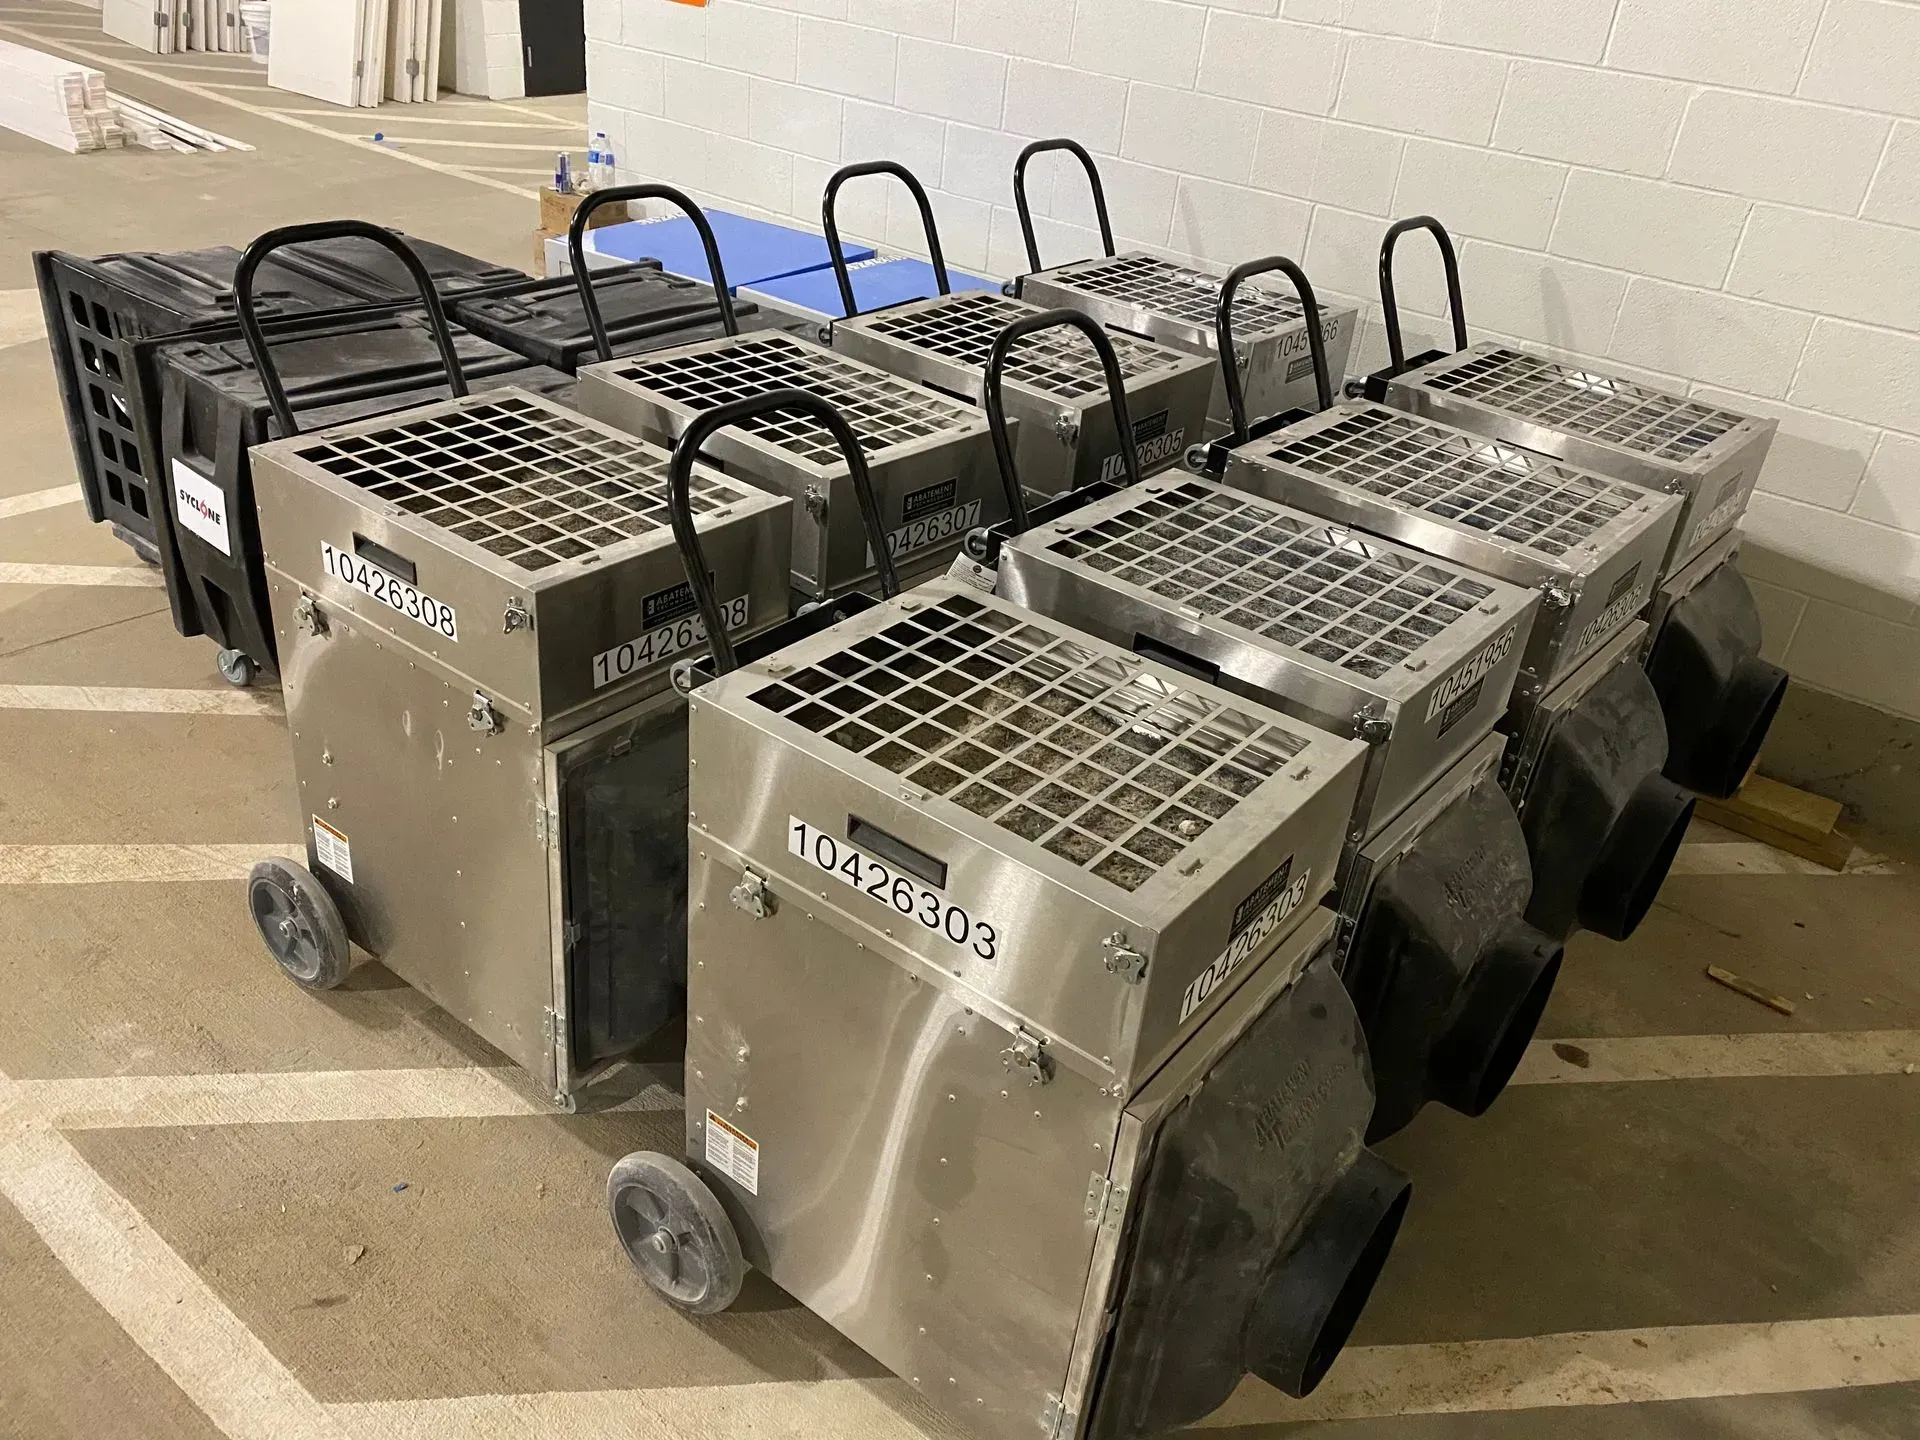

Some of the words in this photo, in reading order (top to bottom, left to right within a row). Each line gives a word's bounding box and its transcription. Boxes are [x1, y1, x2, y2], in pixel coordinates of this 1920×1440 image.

[1277, 319, 1339, 359] 104566
[1104, 429, 1183, 480] 1026305
[325, 546, 455, 637] 10426308
[1431, 626, 1515, 716] 10451956
[793, 823, 997, 960] 10426303
[1185, 873, 1308, 1017] 10426303
